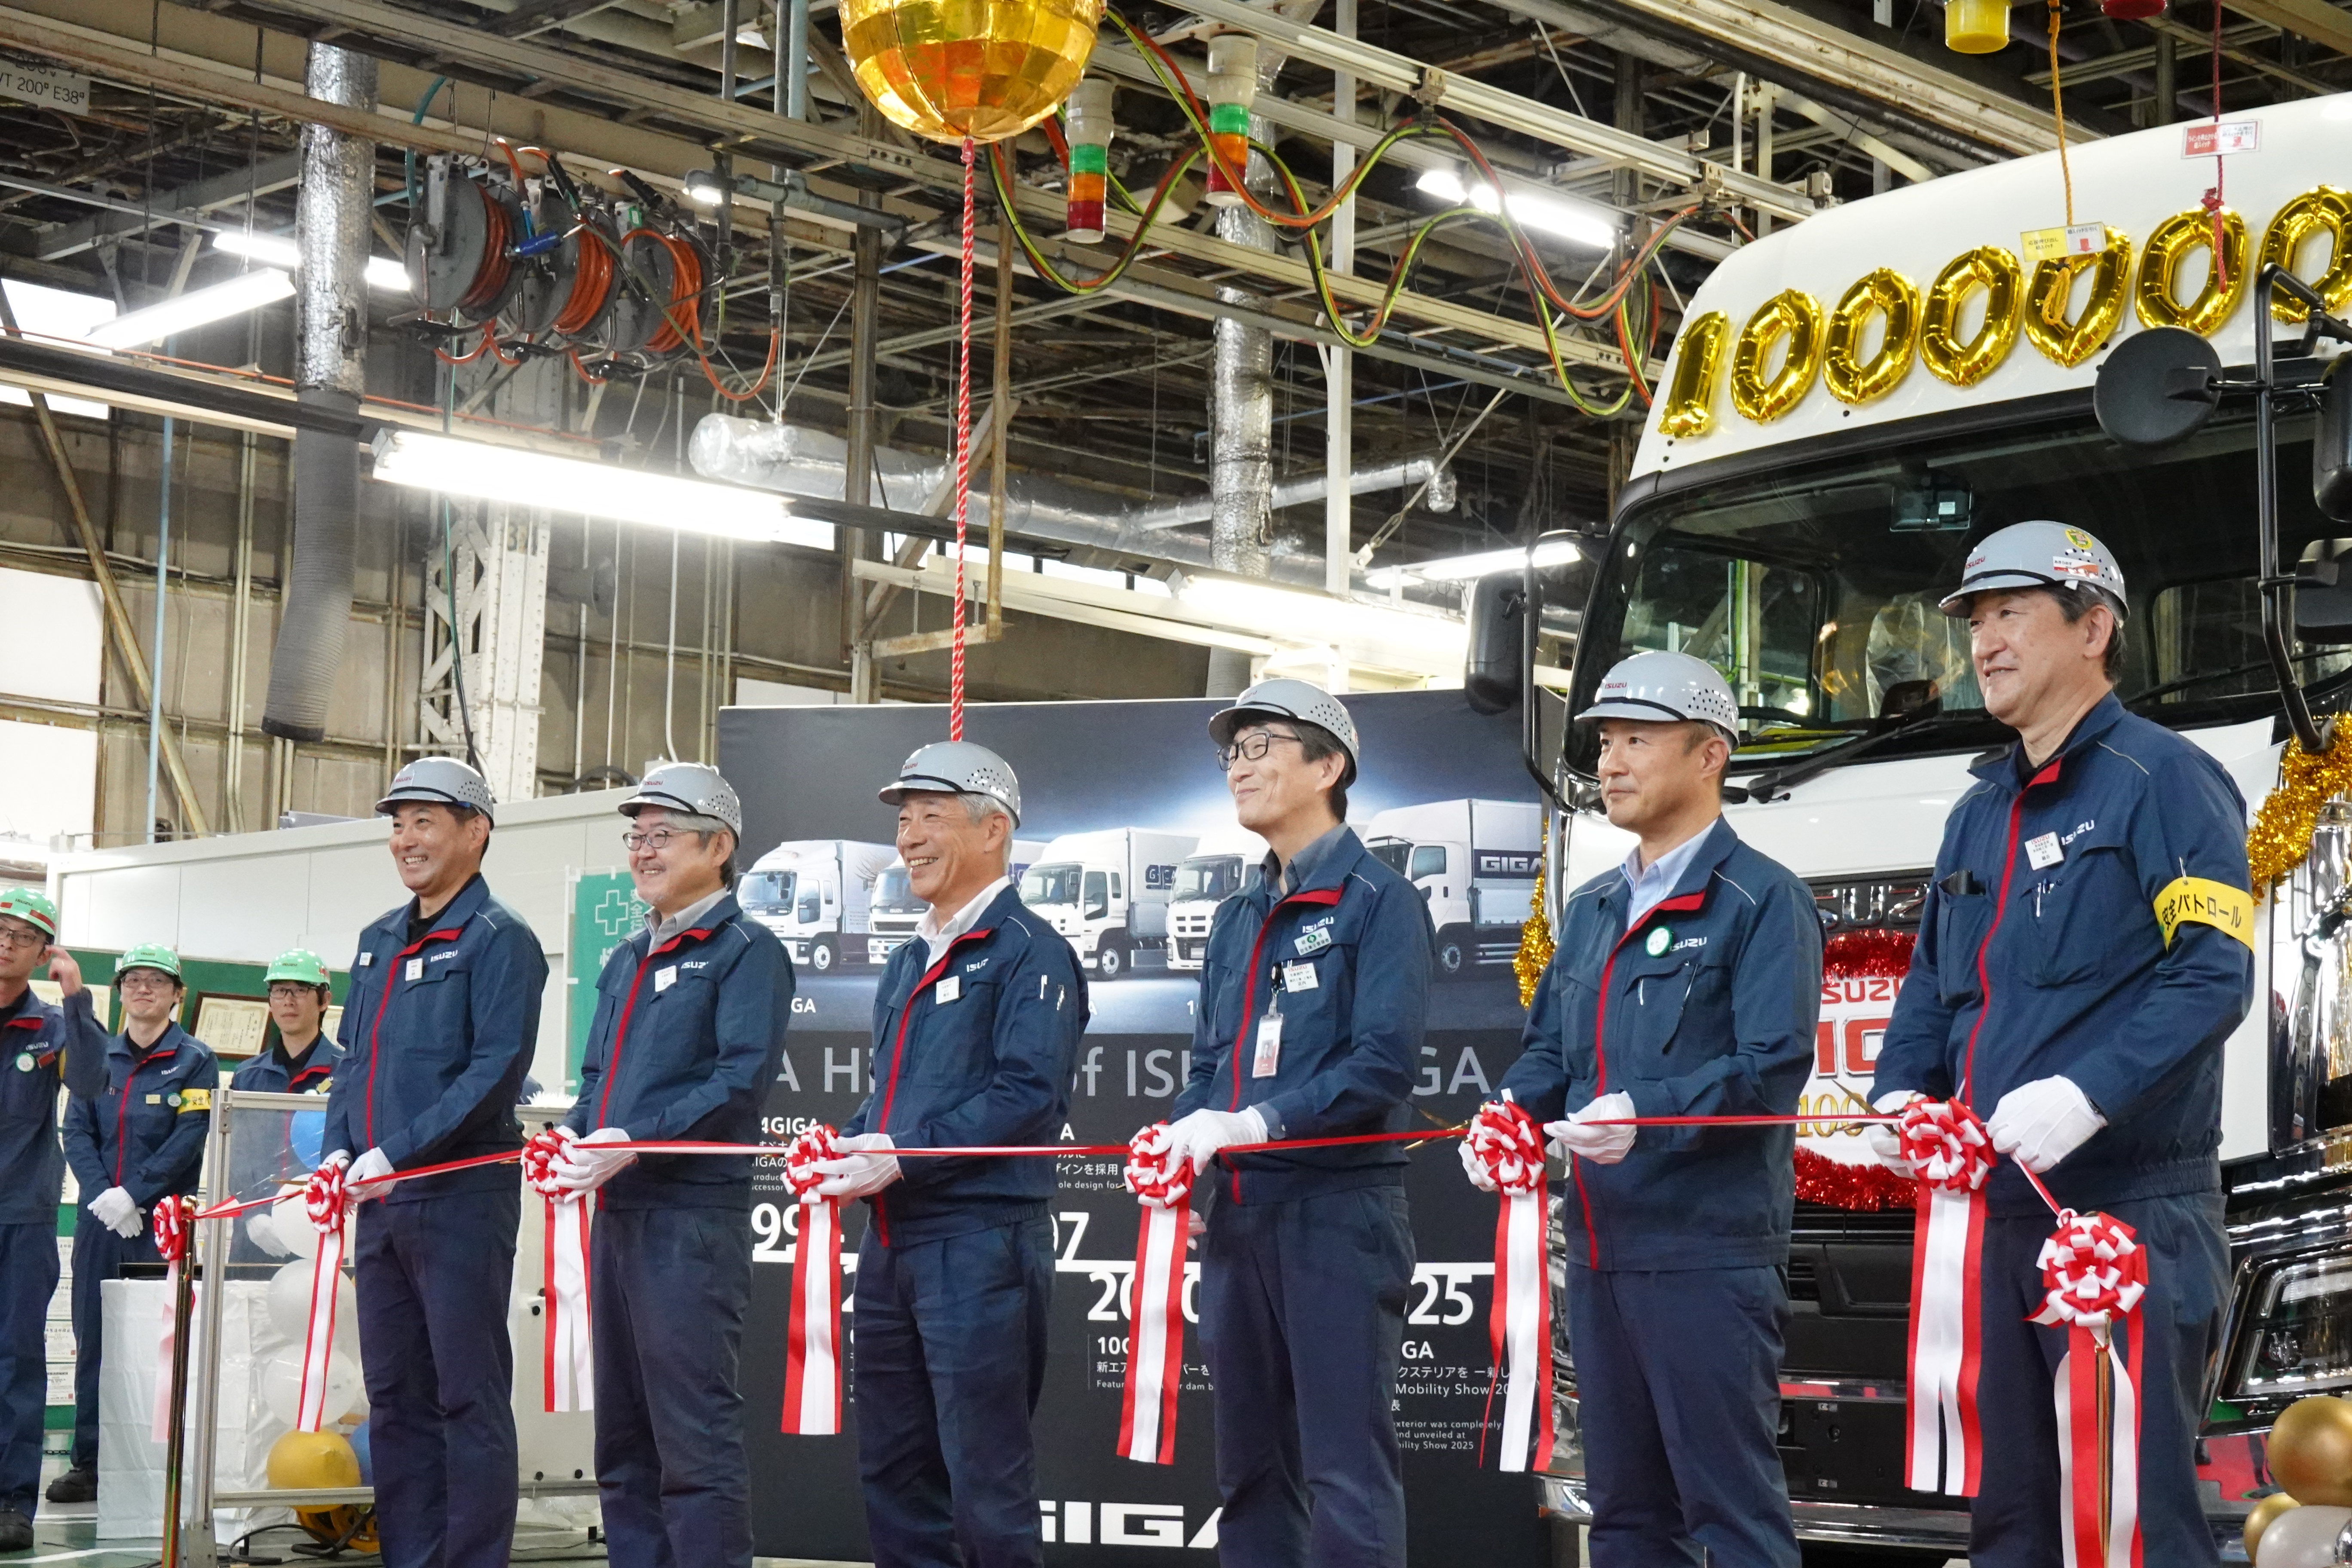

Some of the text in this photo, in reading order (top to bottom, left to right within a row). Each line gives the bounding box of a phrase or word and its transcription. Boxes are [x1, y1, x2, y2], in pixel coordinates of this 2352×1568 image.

[1965, 556, 1986, 570] ISUZU
[2030, 834, 2050, 845] ISUZU
[2162, 894, 2242, 931] 安全パトロール
[430, 949, 458, 963] ISUZU
[1821, 978, 1900, 1005] SUZ
[1073, 1046, 1103, 1096] f
[752, 1157, 787, 1167] IGAの
[1075, 1179, 1103, 1191] design
[1050, 1212, 1089, 1260] 7
[1404, 1274, 1473, 1325] 25
[1186, 1382, 1204, 1390] dam
[1395, 1383, 1450, 1398] Mobility
[1455, 1383, 1490, 1395] Show
[1451, 1420, 1501, 1430] compleely
[1397, 1430, 1410, 1439] nd
[1414, 1430, 1453, 1439] unveiled
[1423, 1441, 1448, 1450] Show
[1451, 1441, 1474, 1450] 2025
